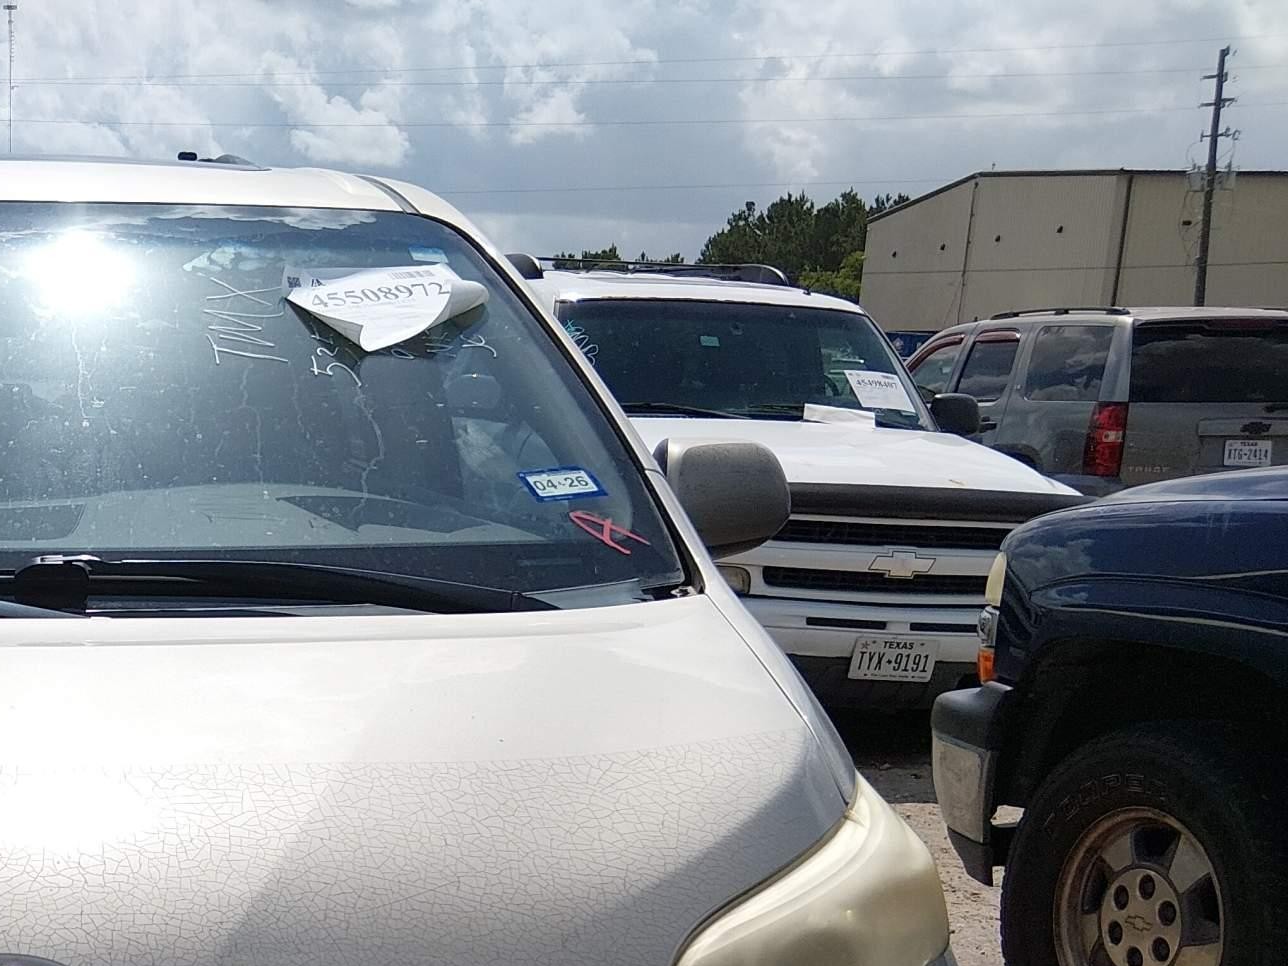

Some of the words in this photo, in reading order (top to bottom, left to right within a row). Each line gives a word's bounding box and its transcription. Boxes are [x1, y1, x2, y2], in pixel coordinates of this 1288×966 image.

[312, 281, 450, 309] 45508972
[569, 510, 651, 554] A
[883, 641, 915, 650] TEXAS
